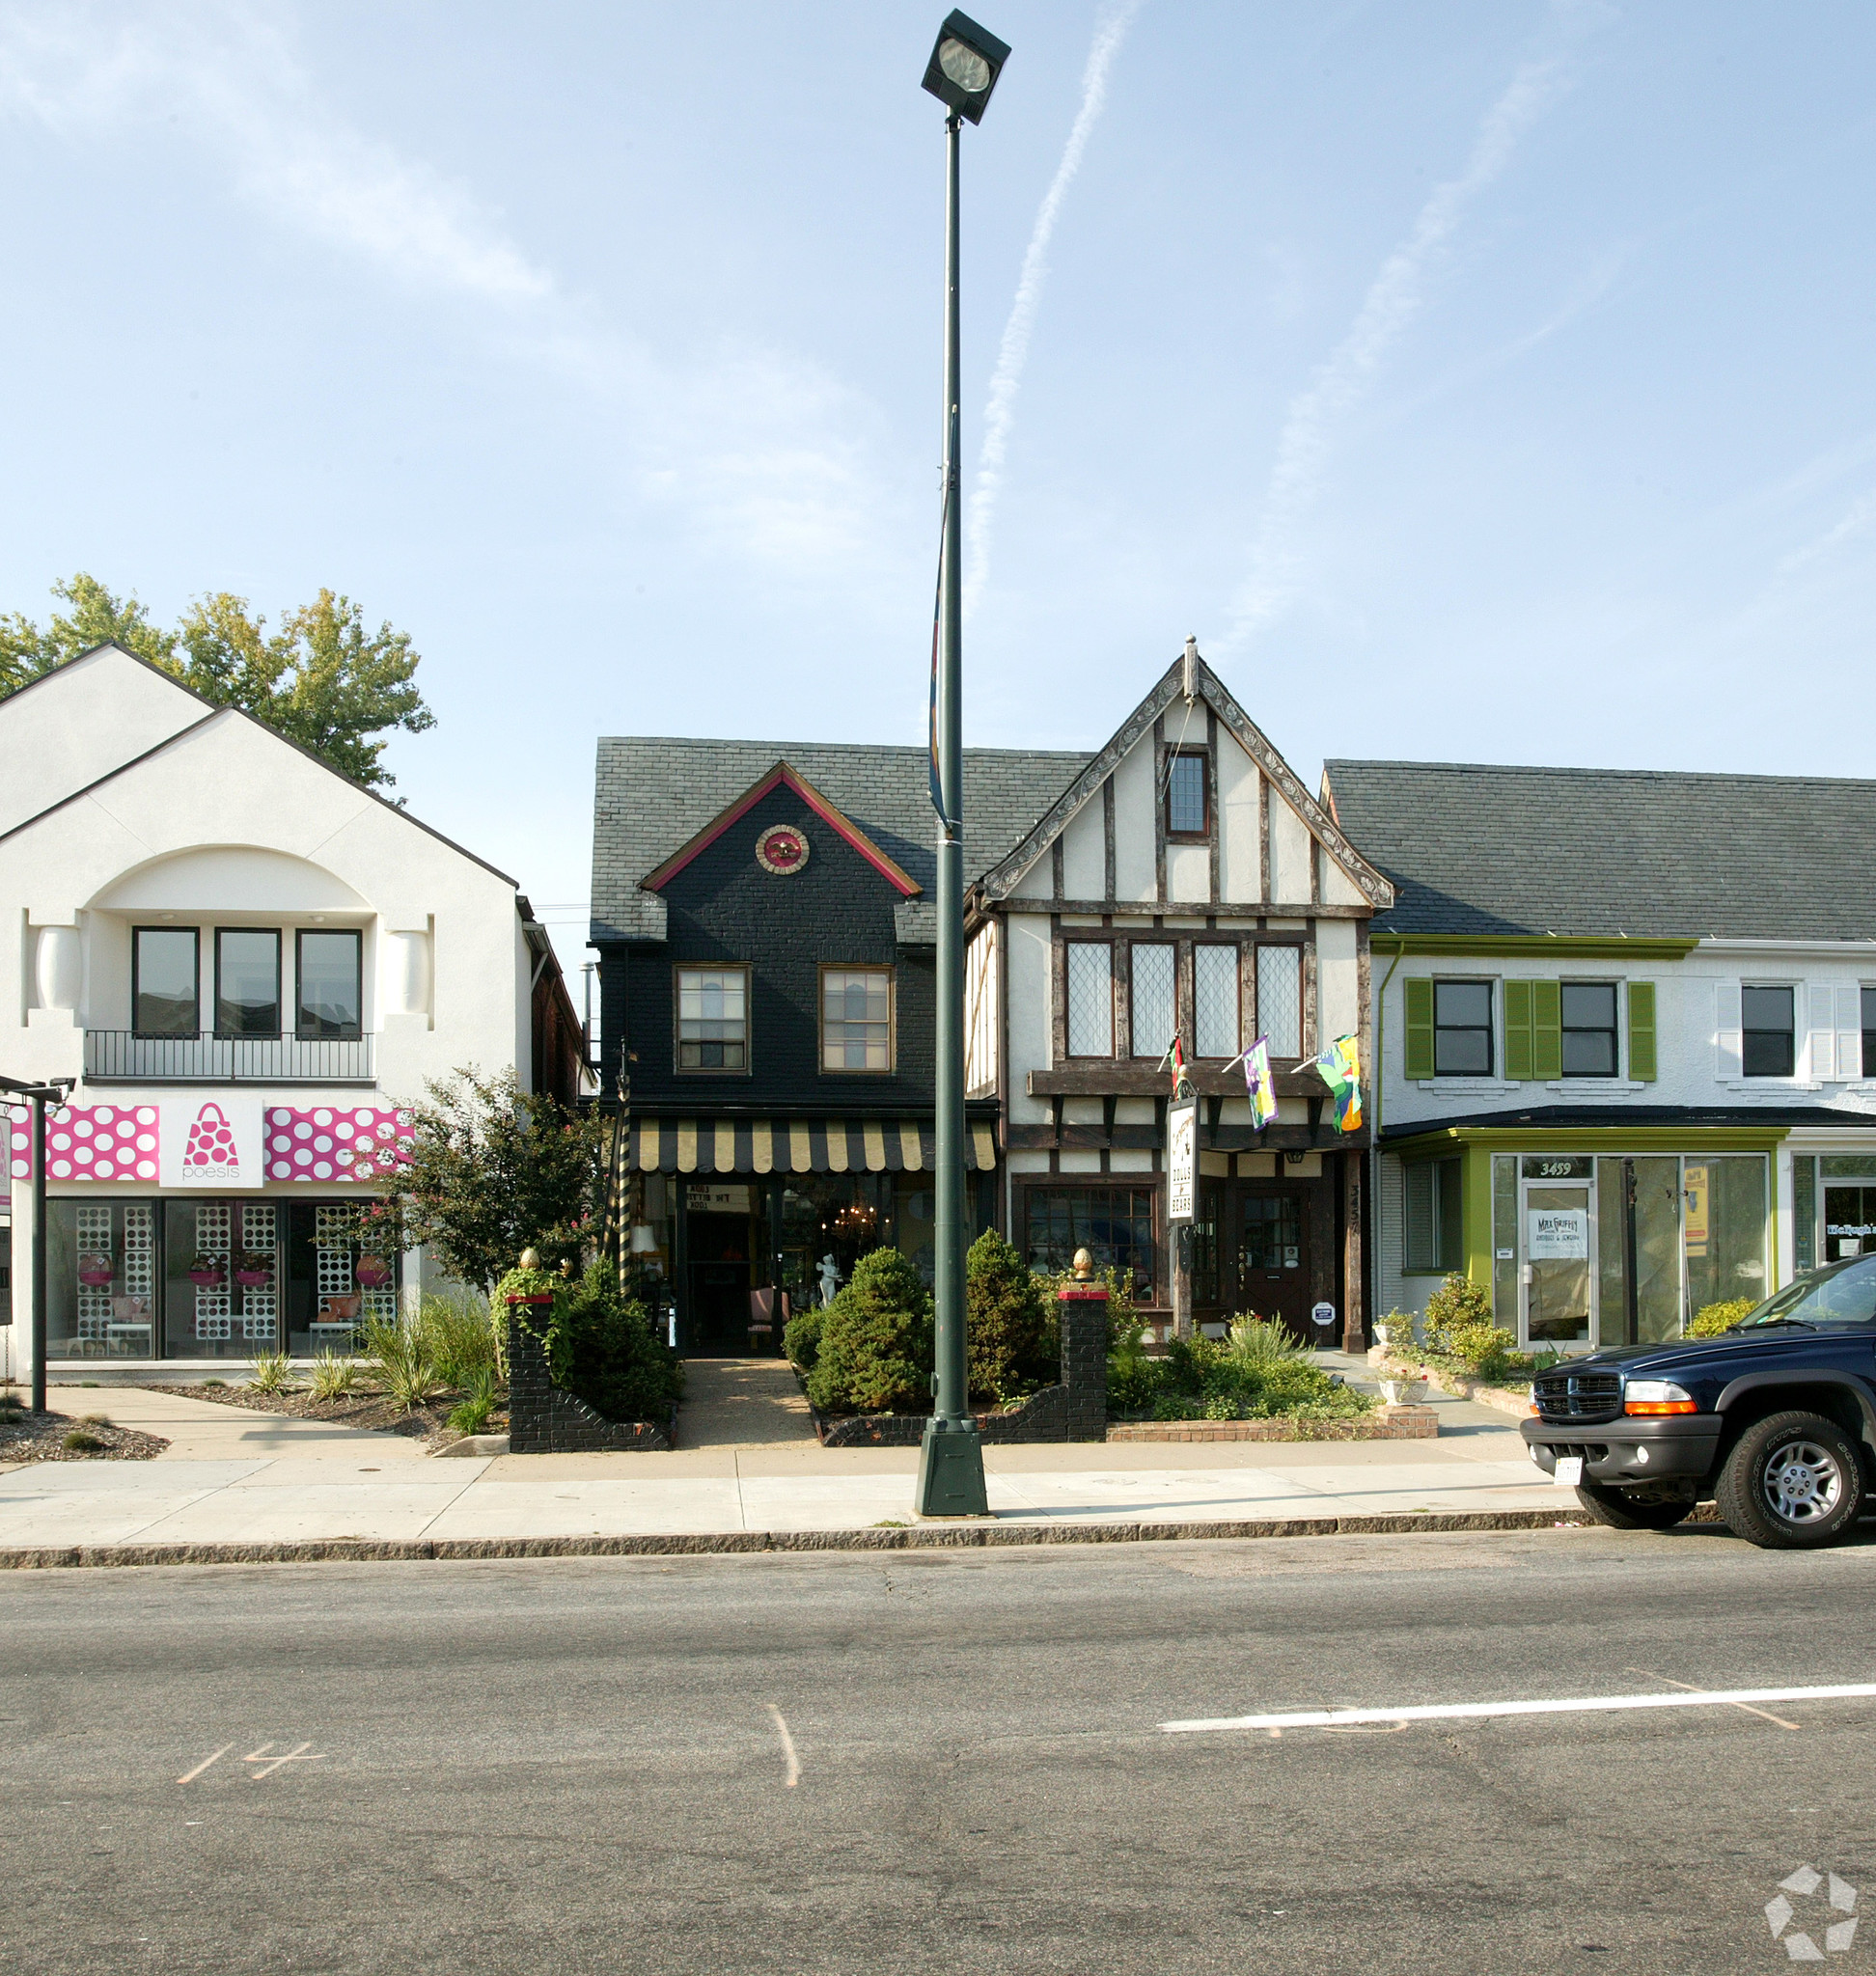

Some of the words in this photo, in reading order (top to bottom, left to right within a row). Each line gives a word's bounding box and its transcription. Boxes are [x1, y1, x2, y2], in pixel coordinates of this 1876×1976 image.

[182, 1166, 239, 1181] poesis
[1540, 1163, 1571, 1175] 3459
[1832, 1442, 1859, 1531] GOODYEAR
